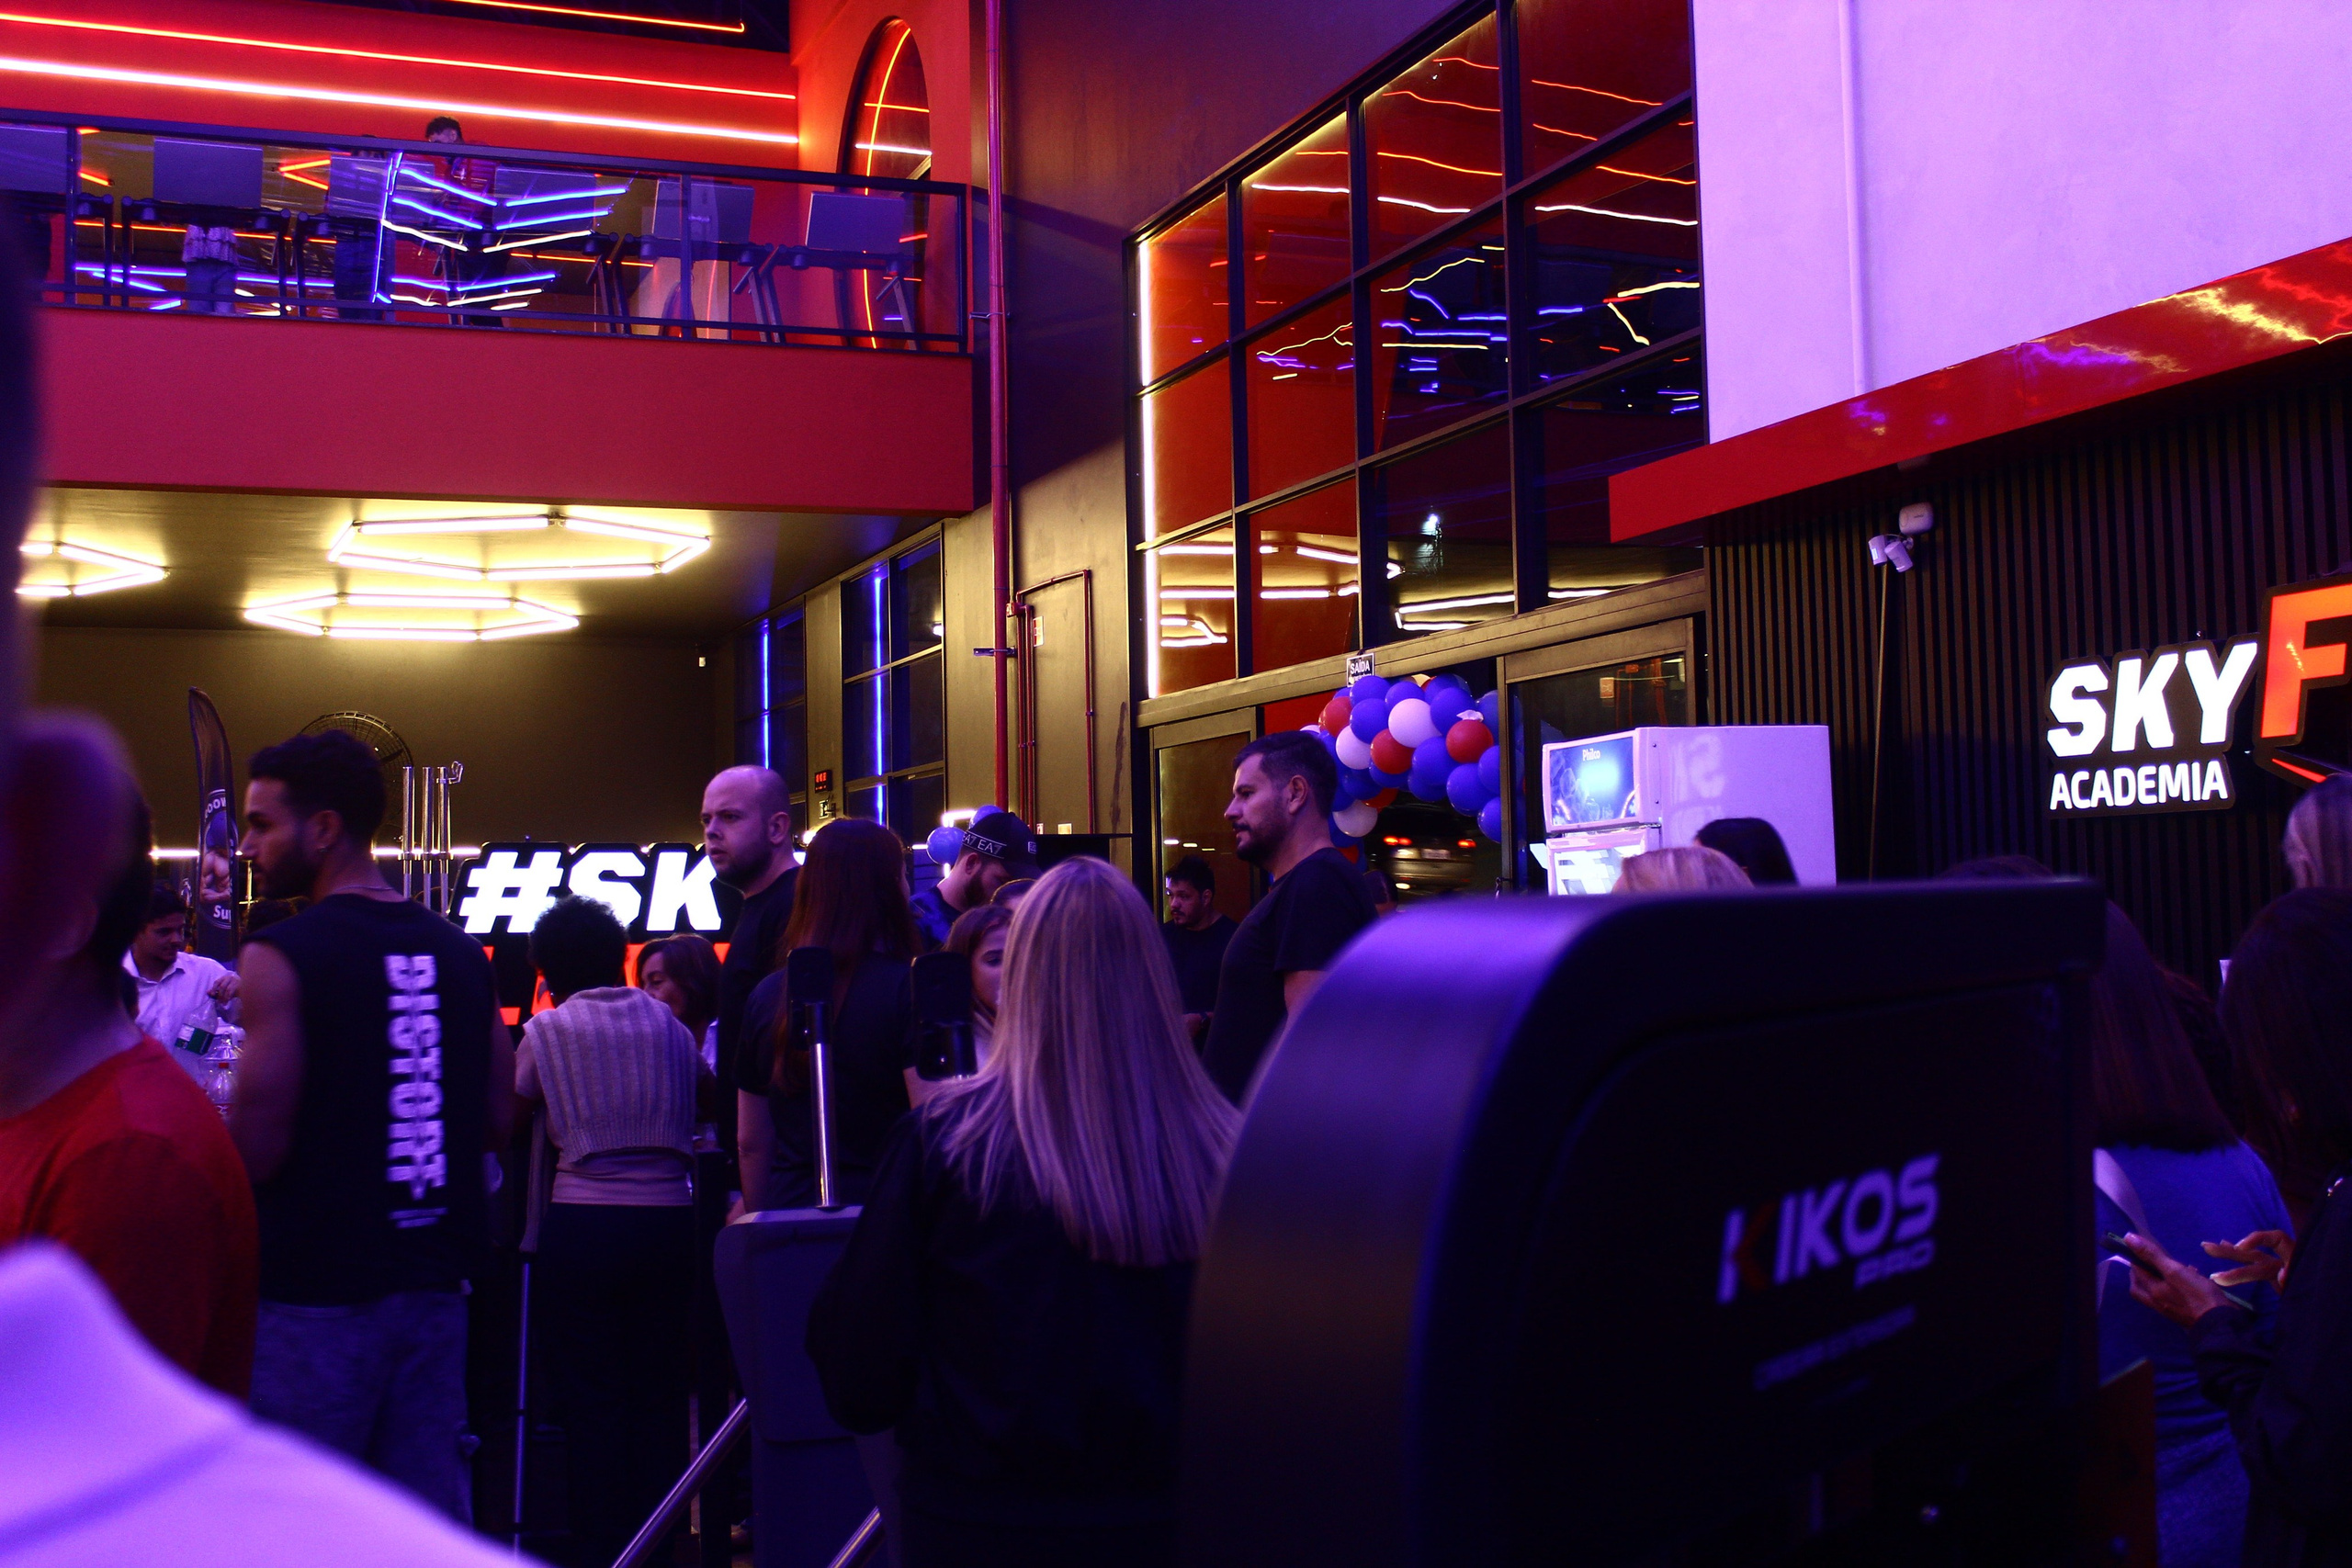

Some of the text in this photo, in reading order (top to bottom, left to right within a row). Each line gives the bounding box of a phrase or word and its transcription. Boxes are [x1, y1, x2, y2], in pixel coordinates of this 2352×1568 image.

[1350, 660, 1371, 674] SAÍDA
[2047, 641, 2257, 758] SKY
[1582, 748, 1601, 761] Philco
[2050, 760, 2228, 810] ACADEMIA
[978, 839, 1002, 855] EA7
[1716, 1151, 1941, 1304] KIKOS
